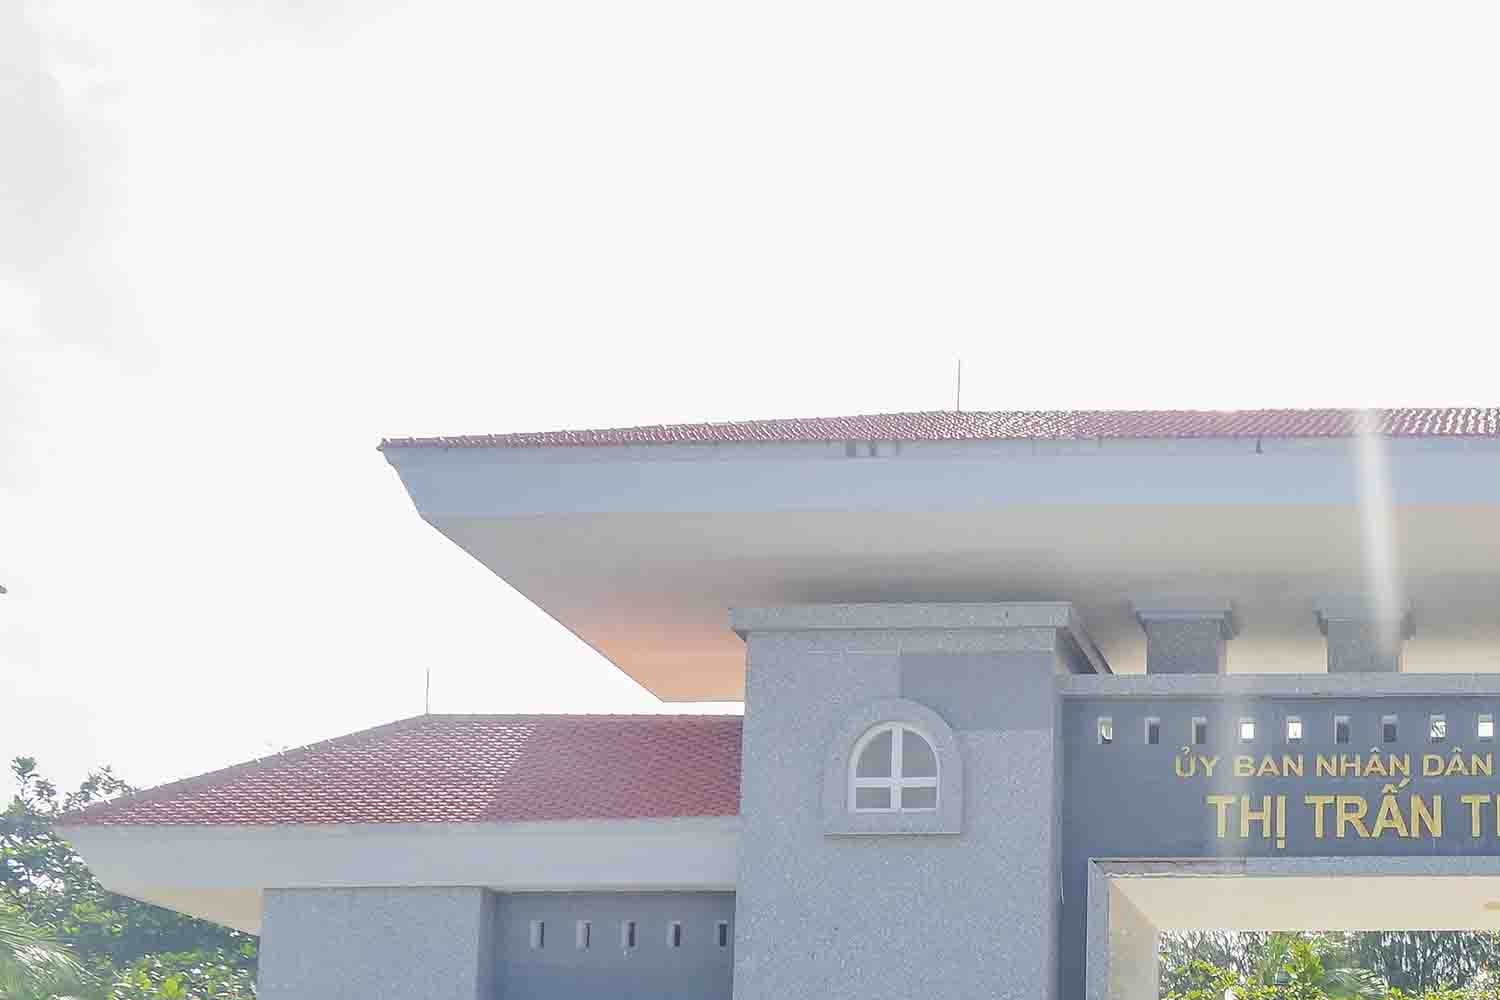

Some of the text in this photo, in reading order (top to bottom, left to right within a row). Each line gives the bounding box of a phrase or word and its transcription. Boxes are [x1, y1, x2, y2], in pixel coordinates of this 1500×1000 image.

[1175, 746, 1218, 777] ỦY
[1232, 754, 1304, 777] BAN
[1316, 746, 1410, 777] NHÂN
[1423, 746, 1492, 776] DÂN
[1206, 794, 1287, 849] THỊ
[1304, 778, 1442, 838] TRẤN
